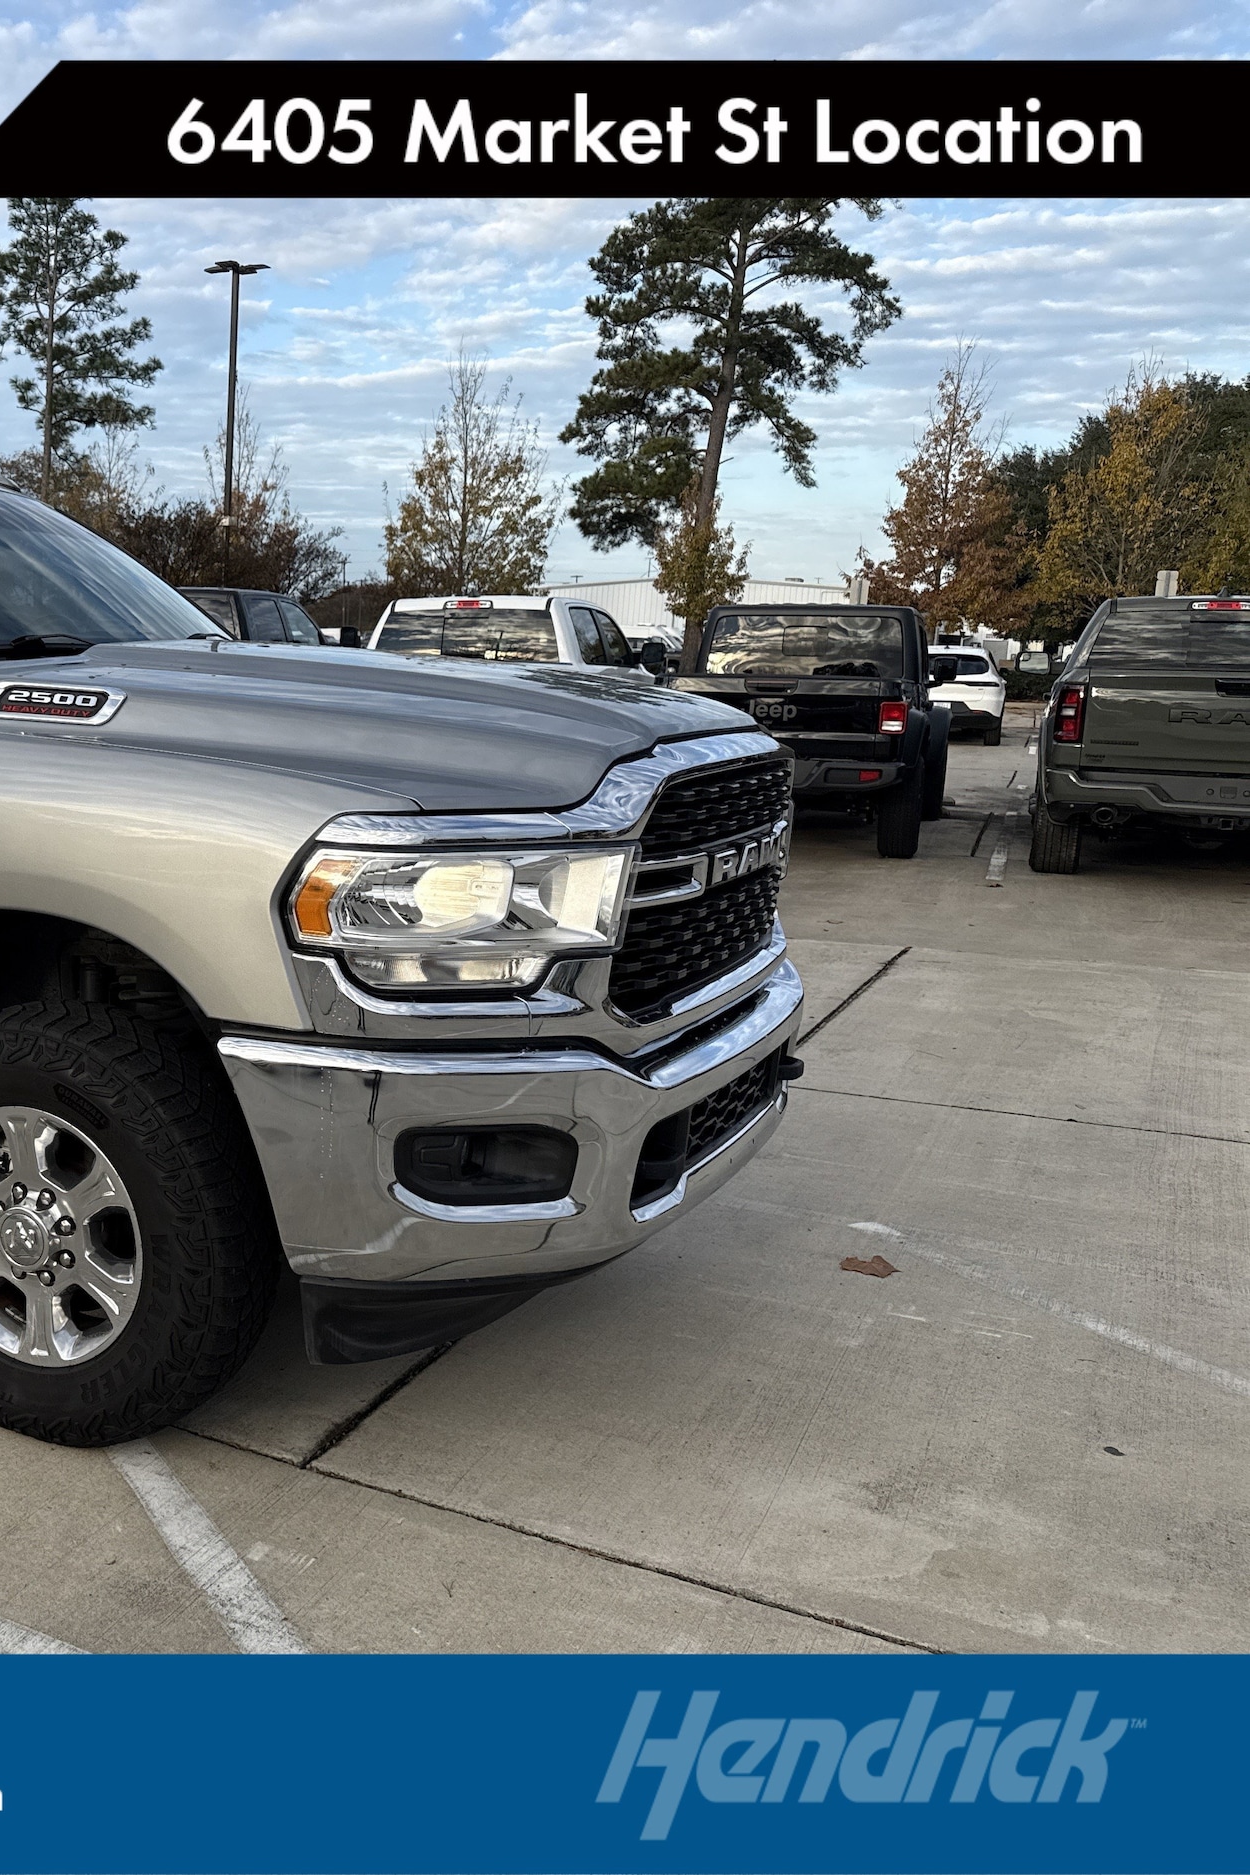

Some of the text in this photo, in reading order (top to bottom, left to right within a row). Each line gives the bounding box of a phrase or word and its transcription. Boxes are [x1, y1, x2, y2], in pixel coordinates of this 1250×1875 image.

[8, 690, 98, 708] 2500
[2, 704, 91, 718] HEAVY DUTY
[749, 698, 798, 722] Jeep
[712, 820, 788, 886] RAM
